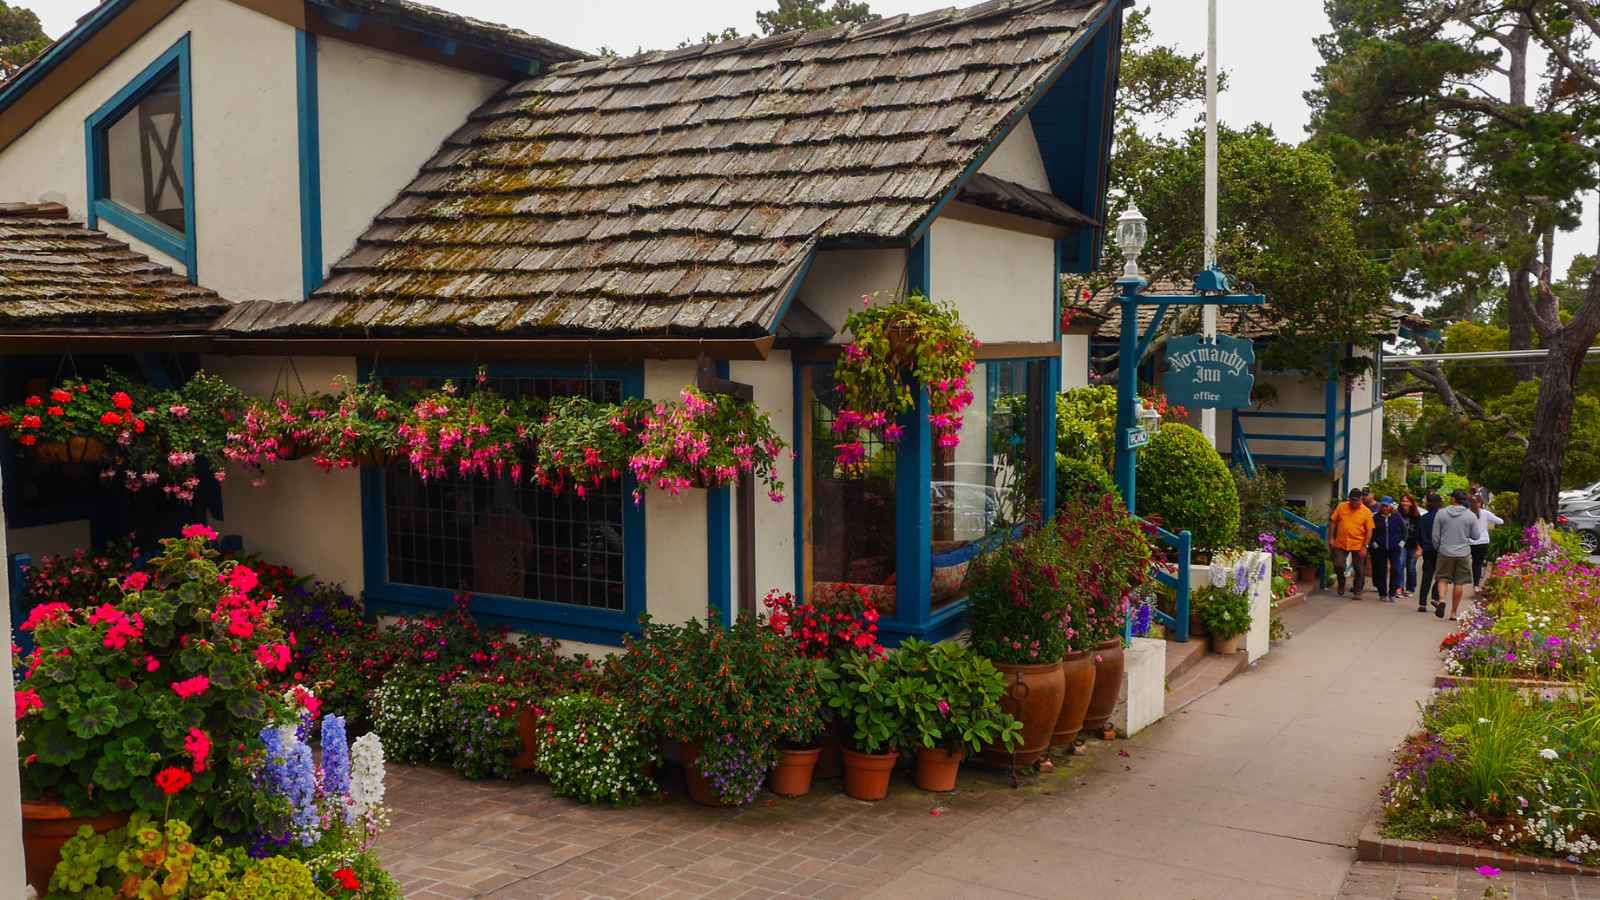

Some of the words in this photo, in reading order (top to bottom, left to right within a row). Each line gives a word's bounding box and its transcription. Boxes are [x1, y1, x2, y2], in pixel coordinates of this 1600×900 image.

[1168, 348, 1247, 376] Normandy
[1193, 365, 1221, 383] Inn
[1193, 391, 1220, 401] office
